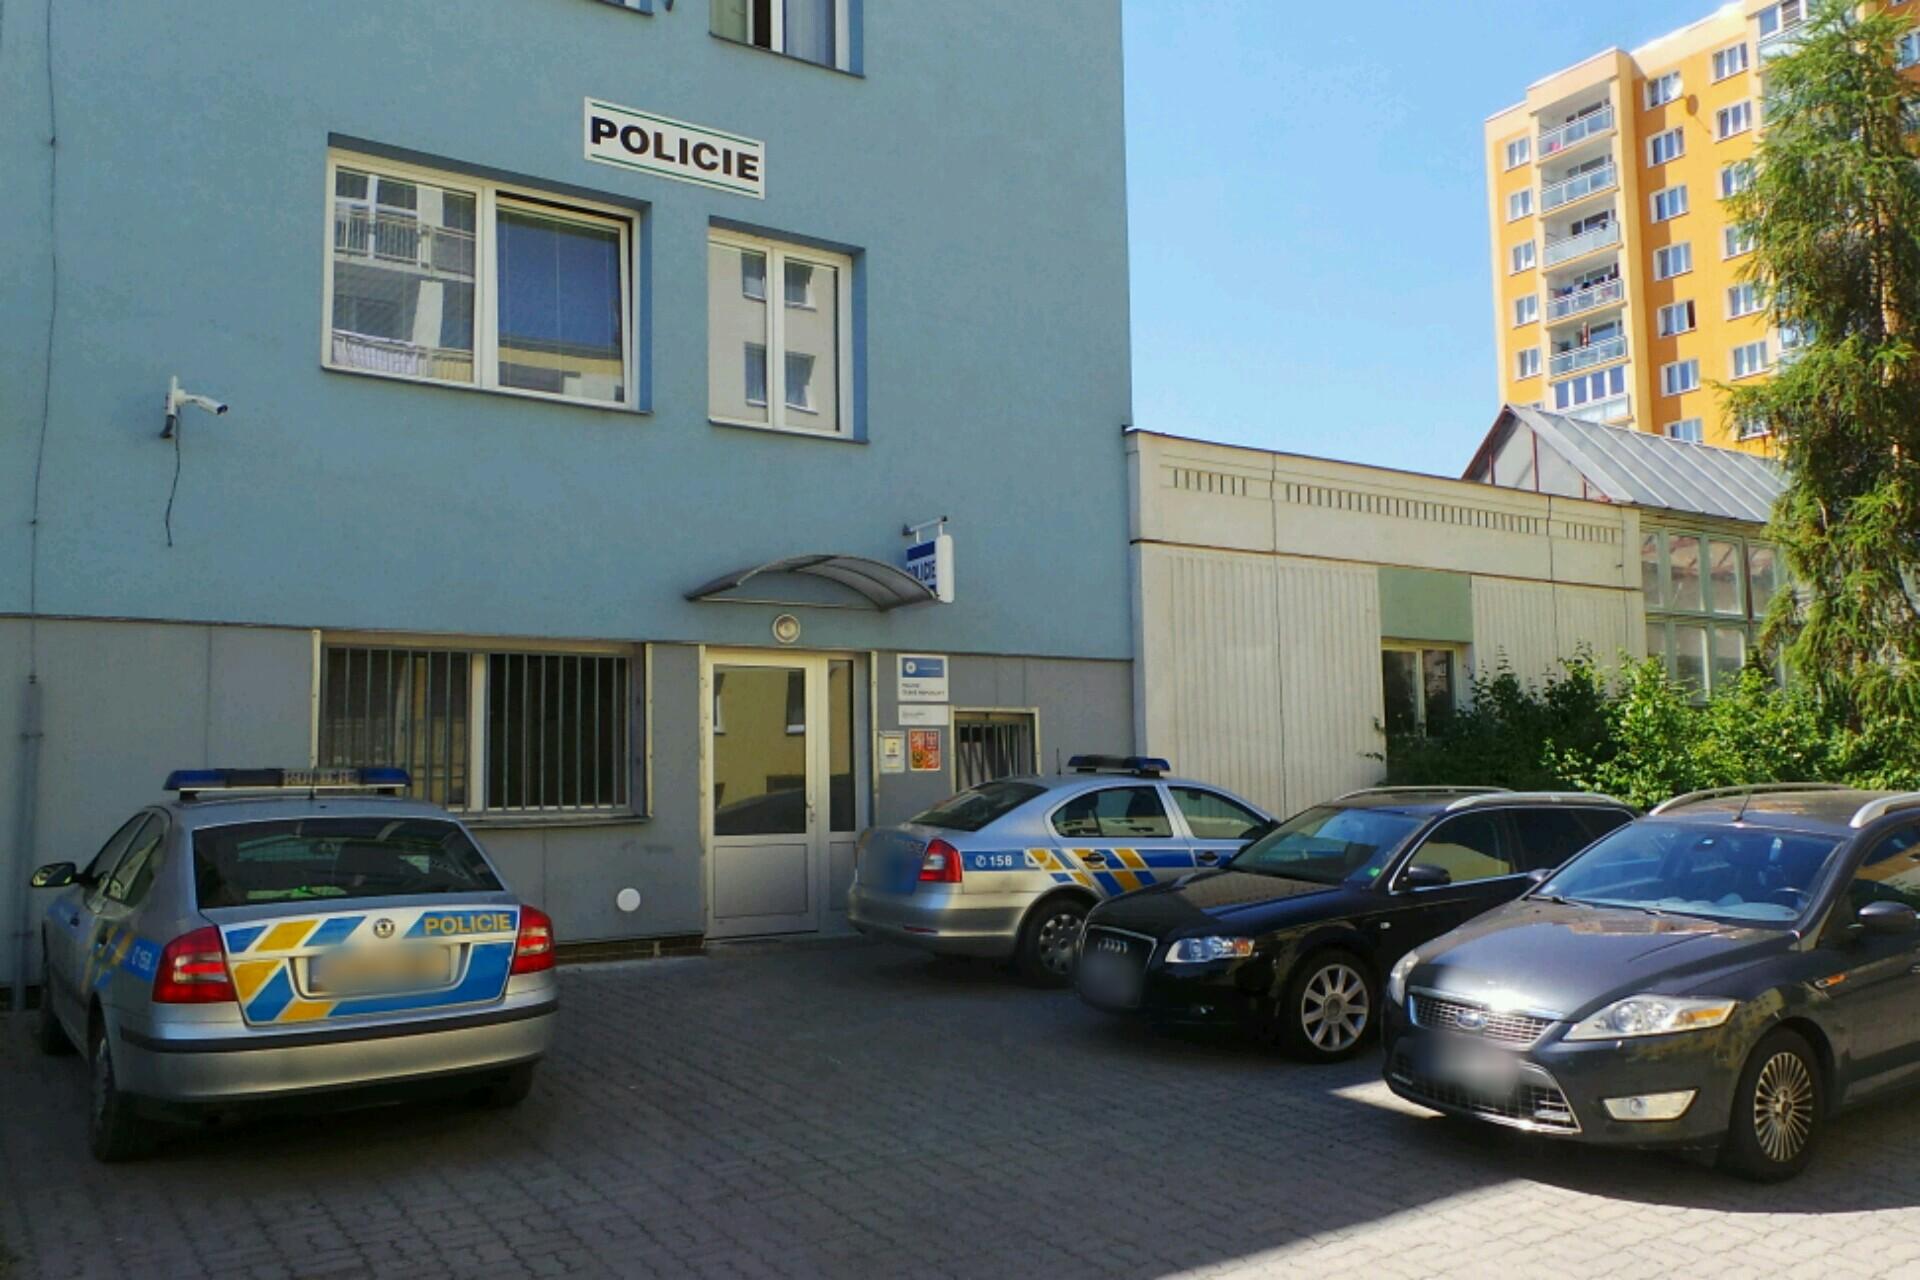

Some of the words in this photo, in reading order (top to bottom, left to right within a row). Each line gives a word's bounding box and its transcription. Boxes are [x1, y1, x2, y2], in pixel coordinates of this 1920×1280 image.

[591, 115, 759, 182] POLICIE
[989, 854, 1013, 867] 158
[424, 913, 512, 935] POLICIE
